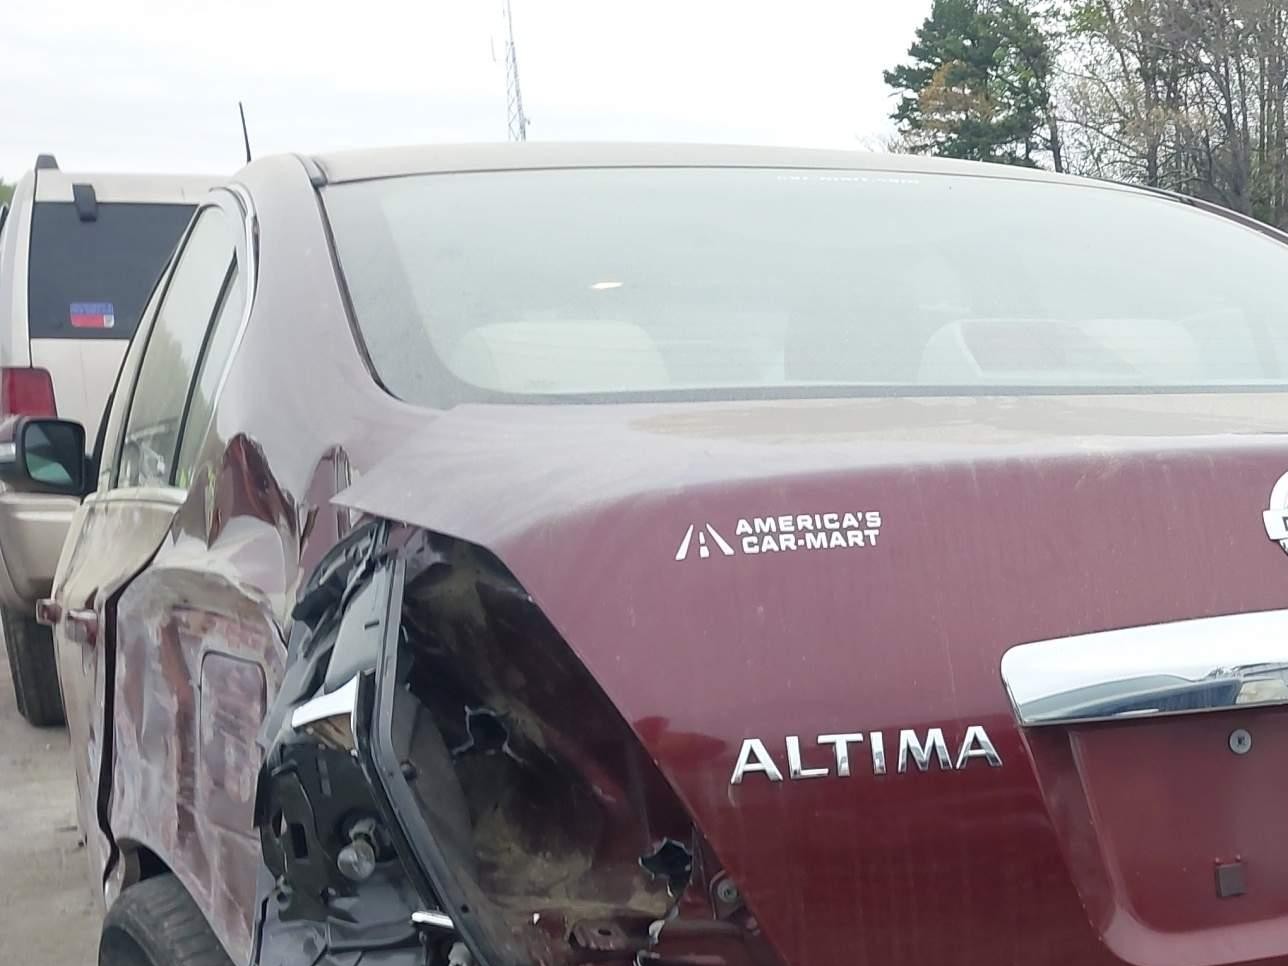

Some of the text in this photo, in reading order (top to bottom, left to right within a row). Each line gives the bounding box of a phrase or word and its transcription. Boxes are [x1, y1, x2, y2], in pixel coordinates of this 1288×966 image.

[735, 511, 882, 535] AMERICA'S
[741, 529, 880, 554] CAR-MART
[730, 725, 1003, 785] ALTIMA
